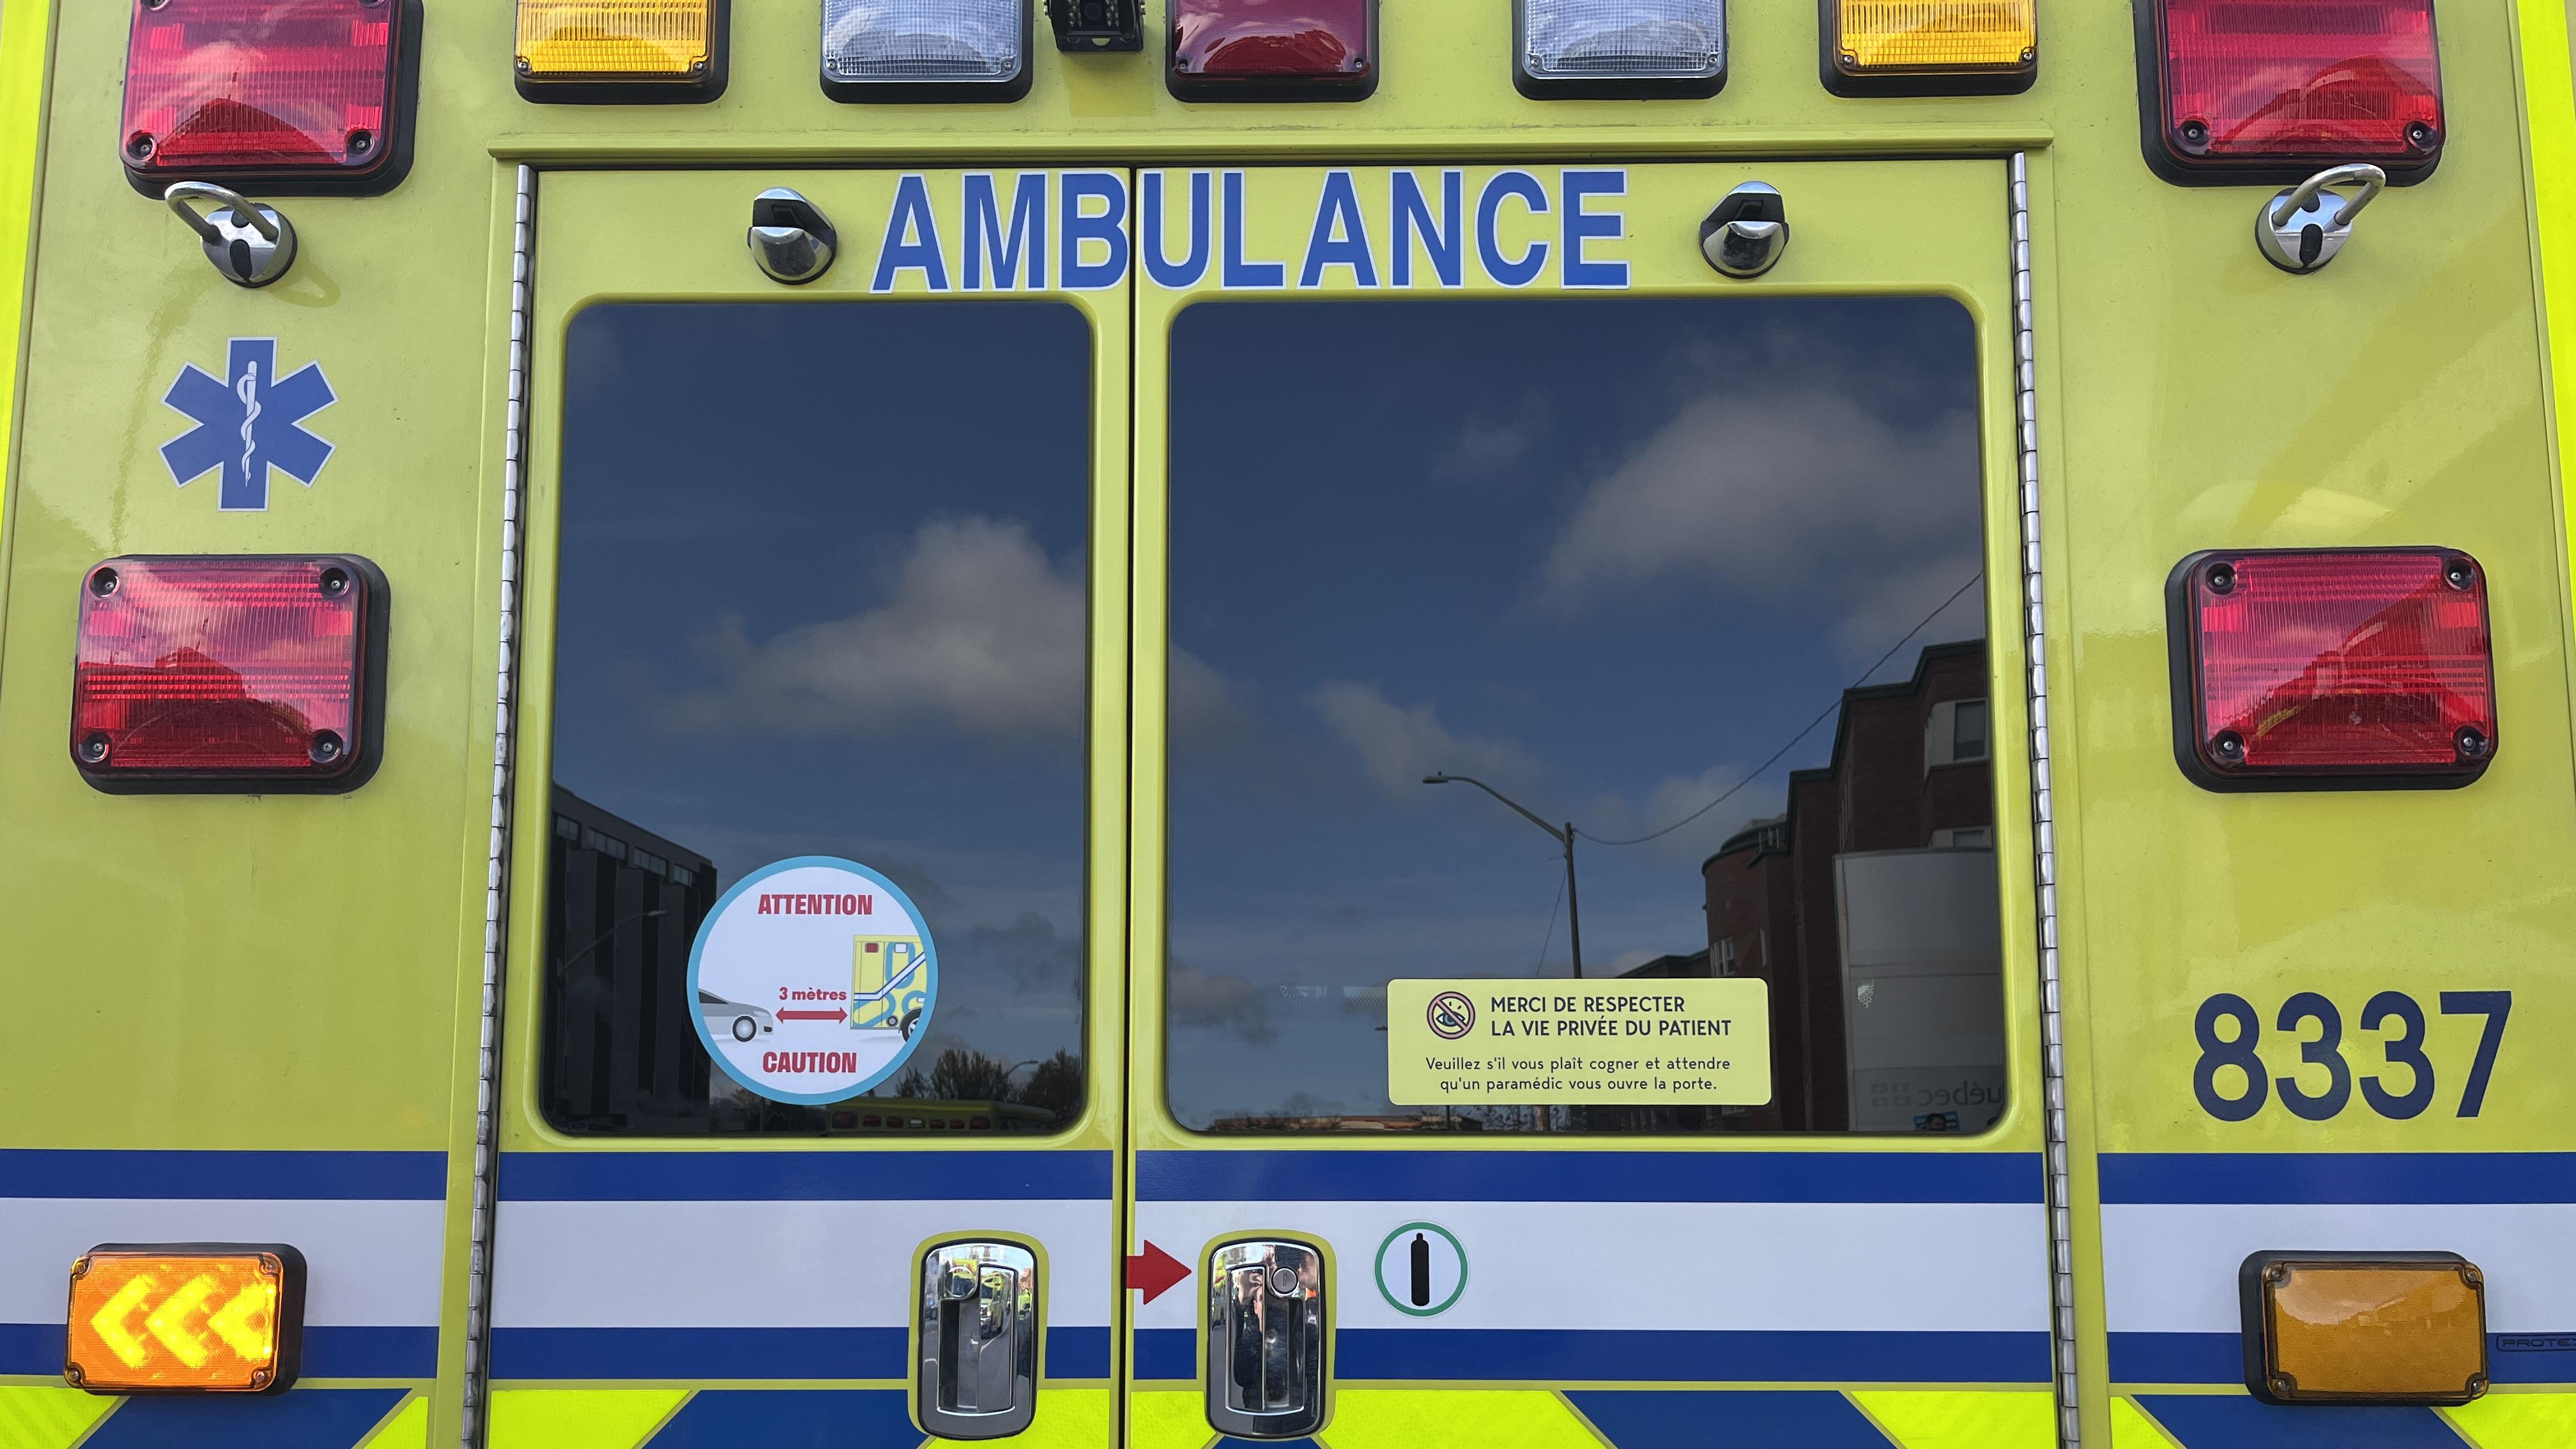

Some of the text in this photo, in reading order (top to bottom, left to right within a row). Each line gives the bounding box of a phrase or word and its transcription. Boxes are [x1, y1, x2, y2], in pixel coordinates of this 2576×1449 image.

[870, 168, 1631, 294] AMBULANCE
[758, 894, 873, 916] ATTENTION
[779, 986, 847, 1001] 3 mètres
[1491, 996, 1685, 1013] MERCI DE RESPECTER
[1491, 1015, 1731, 1036] LA VIE PRIVÉE DU PATIENT
[763, 1051, 857, 1074] CAUTION
[1425, 1056, 1730, 1073] Veuillez s'il vous plaît cogner et attendre
[2193, 990, 2513, 1122] 8337
[1440, 1076, 1717, 1093] qu'un paramédic vous ouvre la porte.
